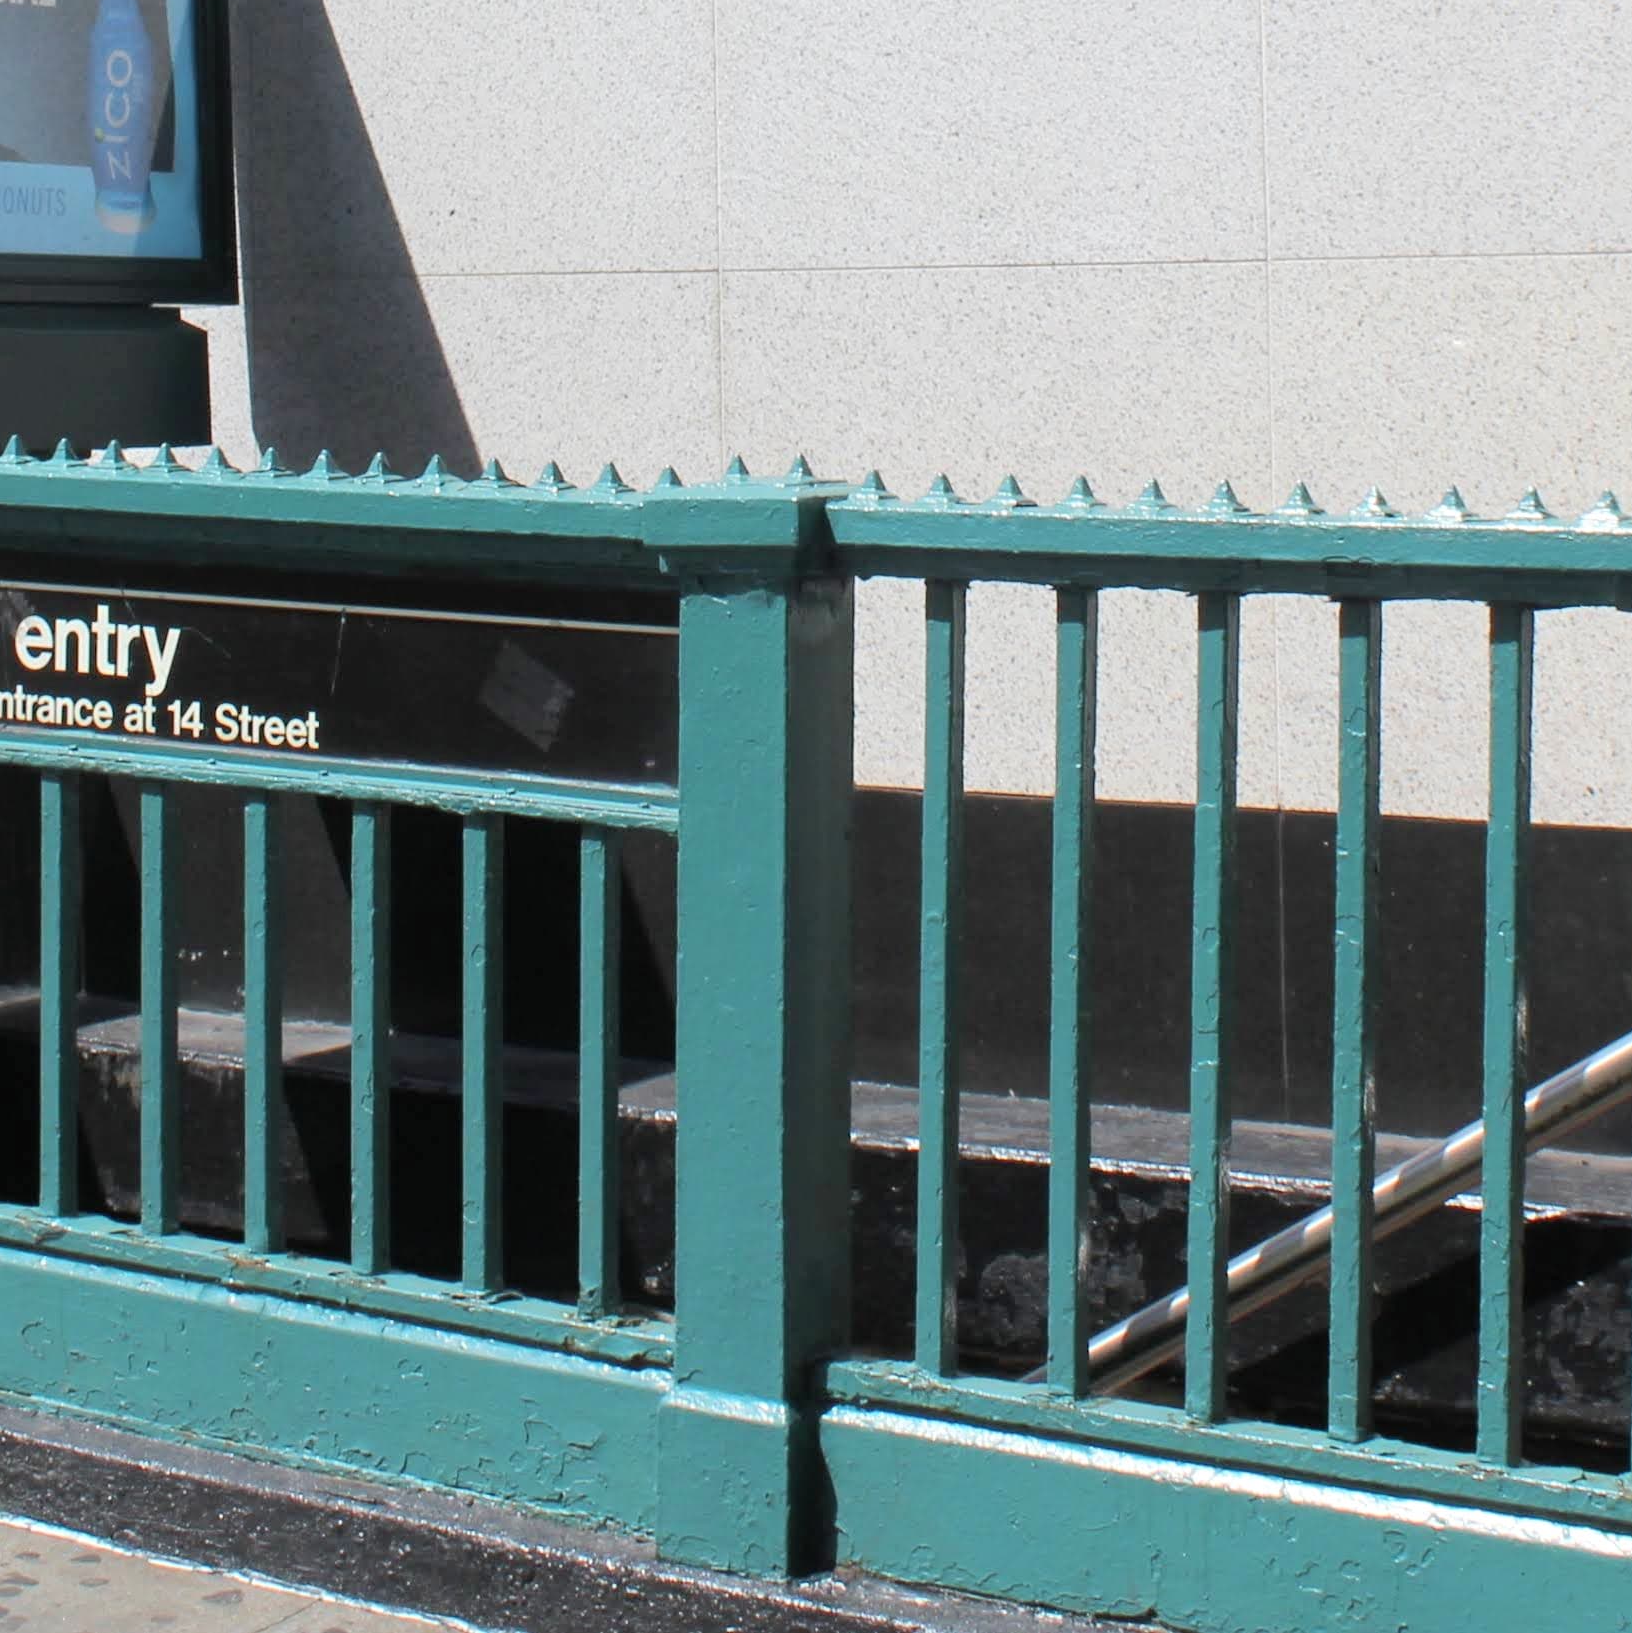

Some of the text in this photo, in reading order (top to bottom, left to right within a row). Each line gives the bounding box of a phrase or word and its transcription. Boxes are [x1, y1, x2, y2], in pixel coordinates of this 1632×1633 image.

[15, 603, 181, 698] entry
[123, 697, 156, 735] at
[167, 699, 204, 738] 14
[215, 702, 320, 750] Street
